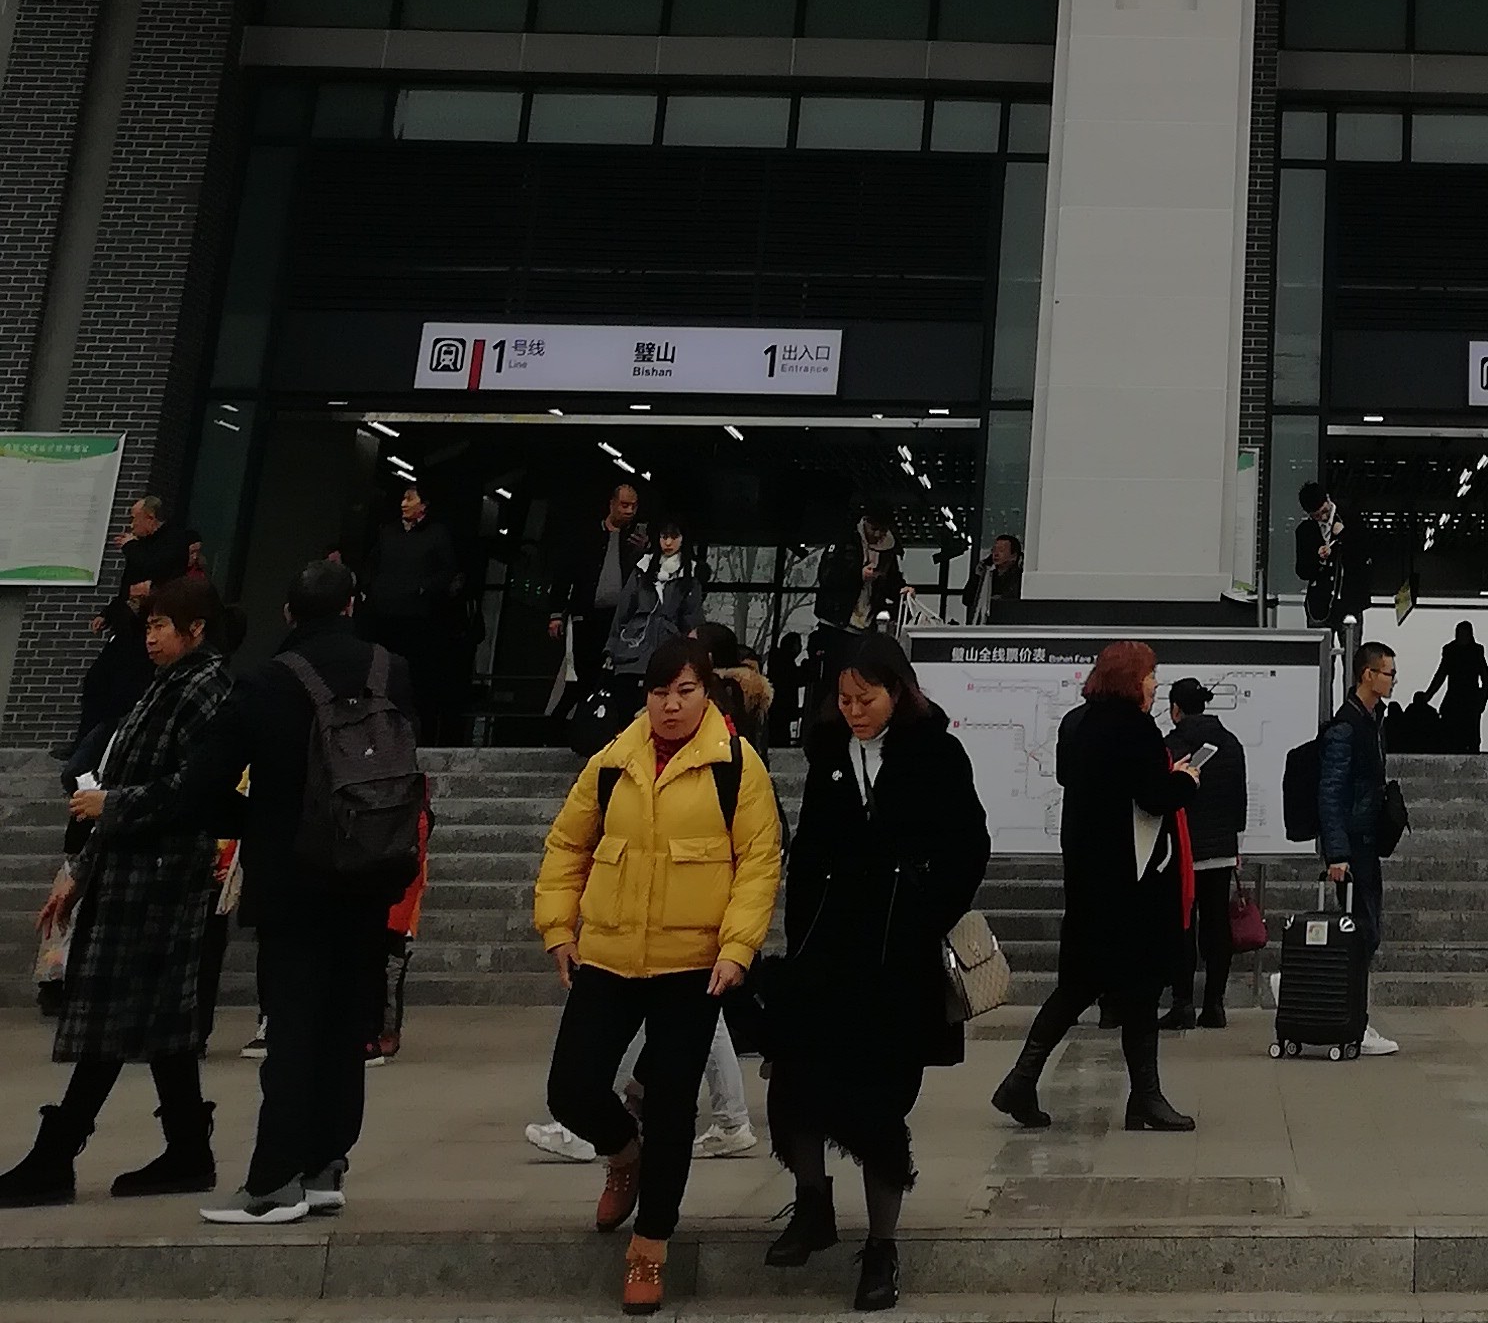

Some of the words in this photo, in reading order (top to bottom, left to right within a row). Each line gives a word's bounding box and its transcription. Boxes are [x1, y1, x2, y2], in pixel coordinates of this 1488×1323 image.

[491, 339, 507, 374] 1
[511, 339, 546, 357] 号线
[633, 341, 677, 365] 璧山
[763, 344, 778, 379] 1
[781, 344, 831, 361] 出入口
[508, 360, 528, 369] Line
[632, 366, 673, 378] Bishan
[780, 363, 830, 374] Entrance
